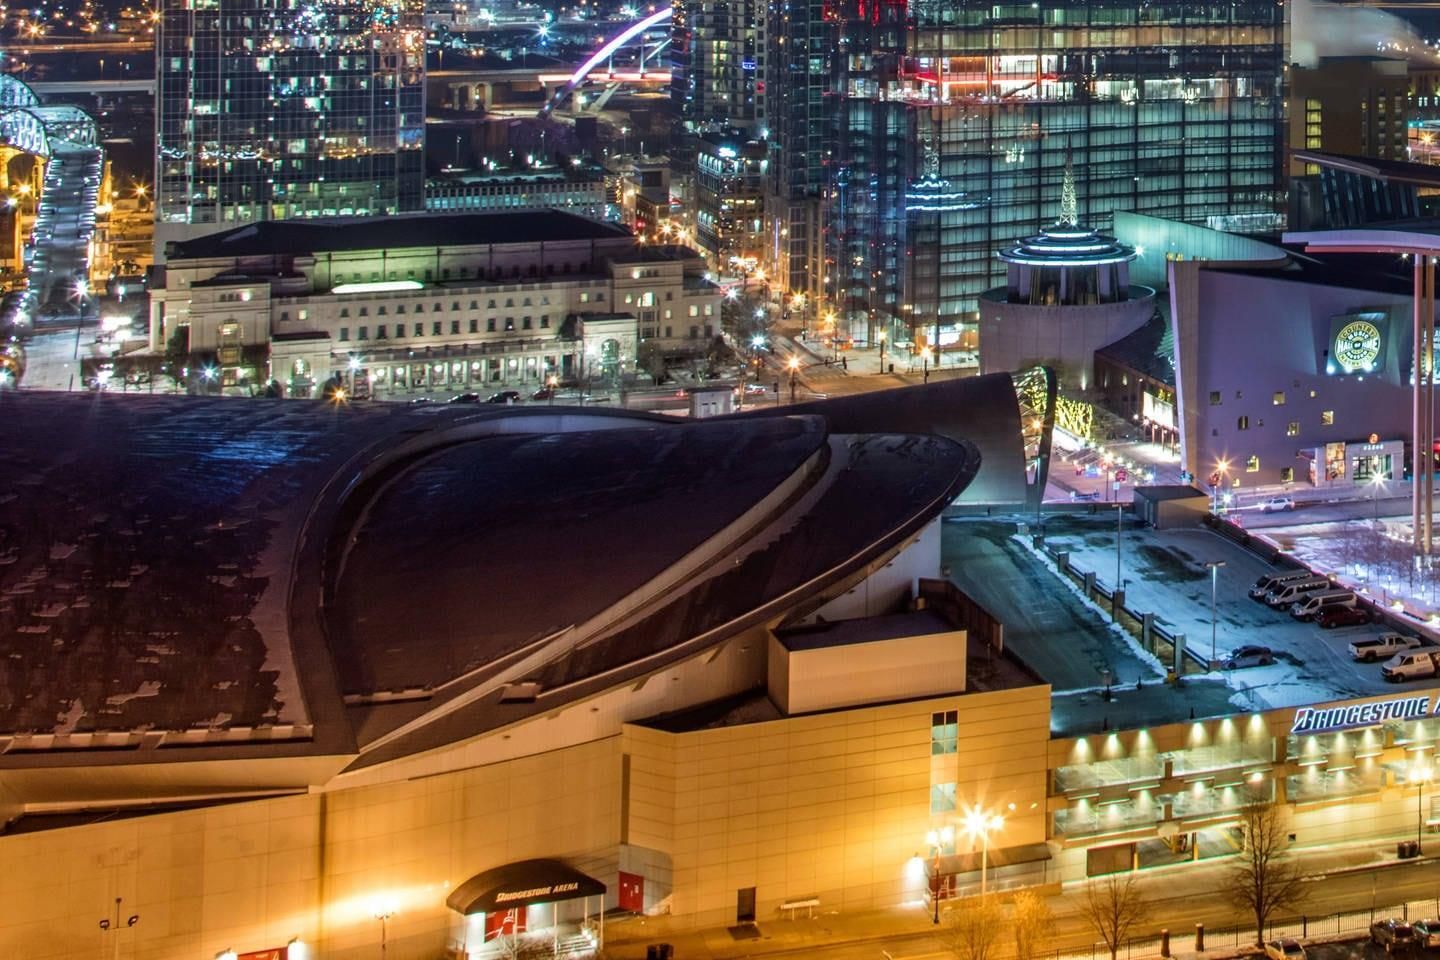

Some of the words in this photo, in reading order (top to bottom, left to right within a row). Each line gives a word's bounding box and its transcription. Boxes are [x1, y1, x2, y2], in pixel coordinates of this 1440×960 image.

[1347, 330, 1369, 340] MUSIC
[1291, 697, 1430, 733] BRIDGESTONE
[495, 886, 552, 903] BRIDGESTONE
[552, 881, 579, 894] ARENA
